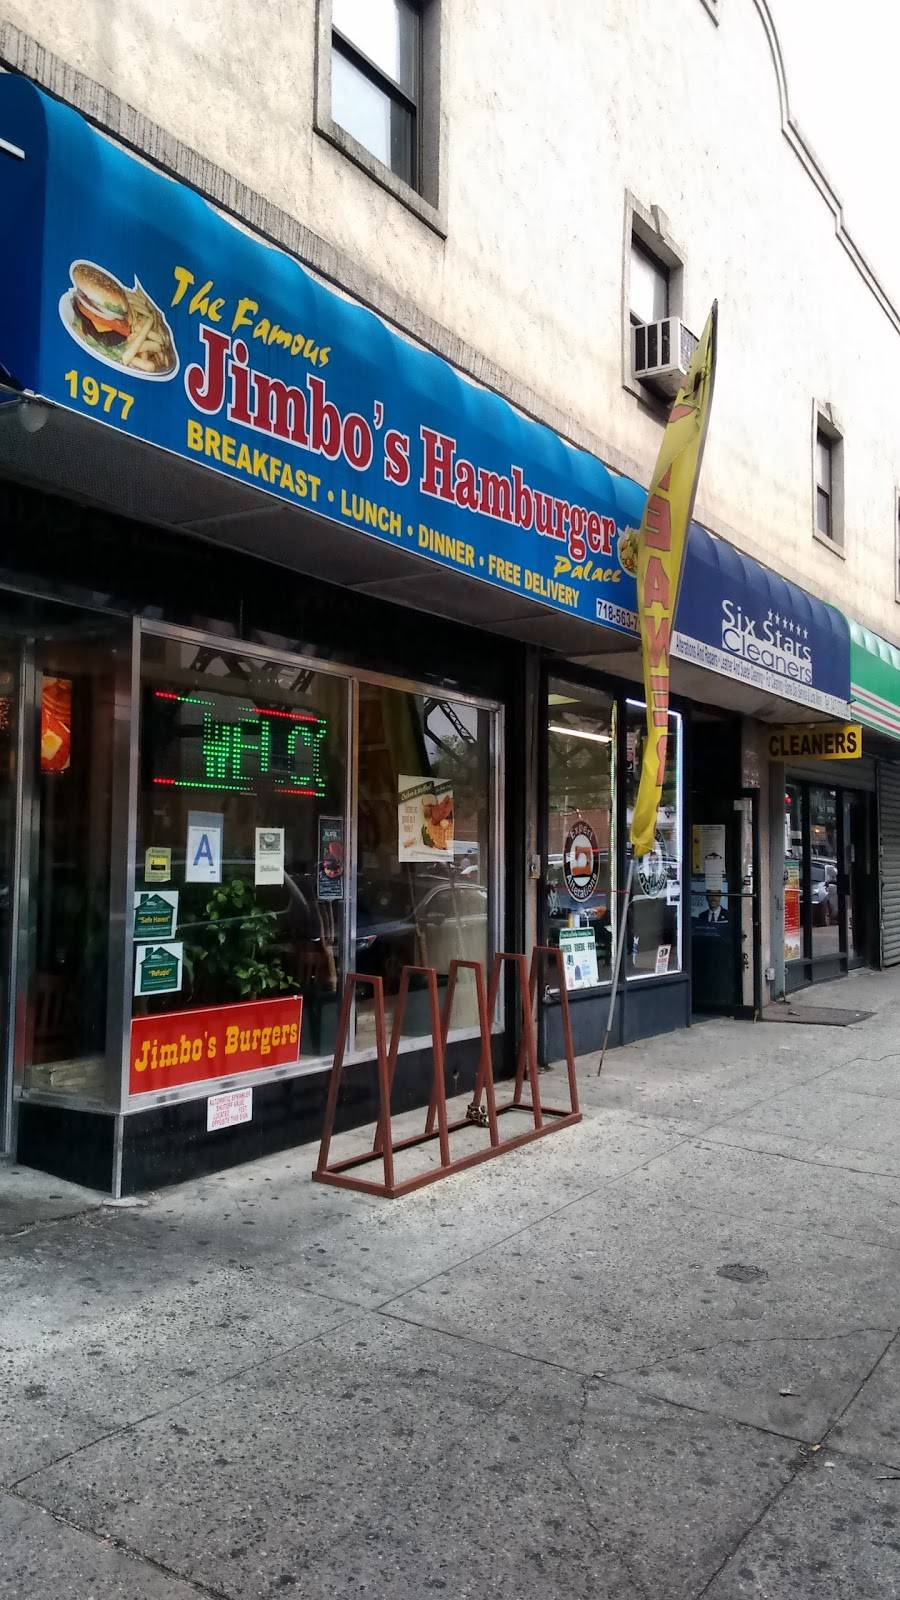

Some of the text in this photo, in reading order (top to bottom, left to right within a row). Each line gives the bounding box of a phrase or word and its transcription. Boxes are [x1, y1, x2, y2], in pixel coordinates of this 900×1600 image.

[171, 266, 332, 368] The Famous
[65, 370, 134, 421] 1977
[184, 323, 617, 562] Jimbo's Hamburger
[187, 419, 580, 608] BREAKFAST LUNCH DINNER FREE DELIVERY
[553, 555, 621, 583] Palace
[597, 600, 641, 632] 718-563-7
[721, 599, 811, 662] Six Stars
[722, 628, 813, 684] Cleaners
[769, 732, 857, 757] CLEANERS
[193, 834, 214, 866] A
[566, 872, 598, 898] Alterations
[134, 1022, 299, 1073] Jimbo's Burgers
